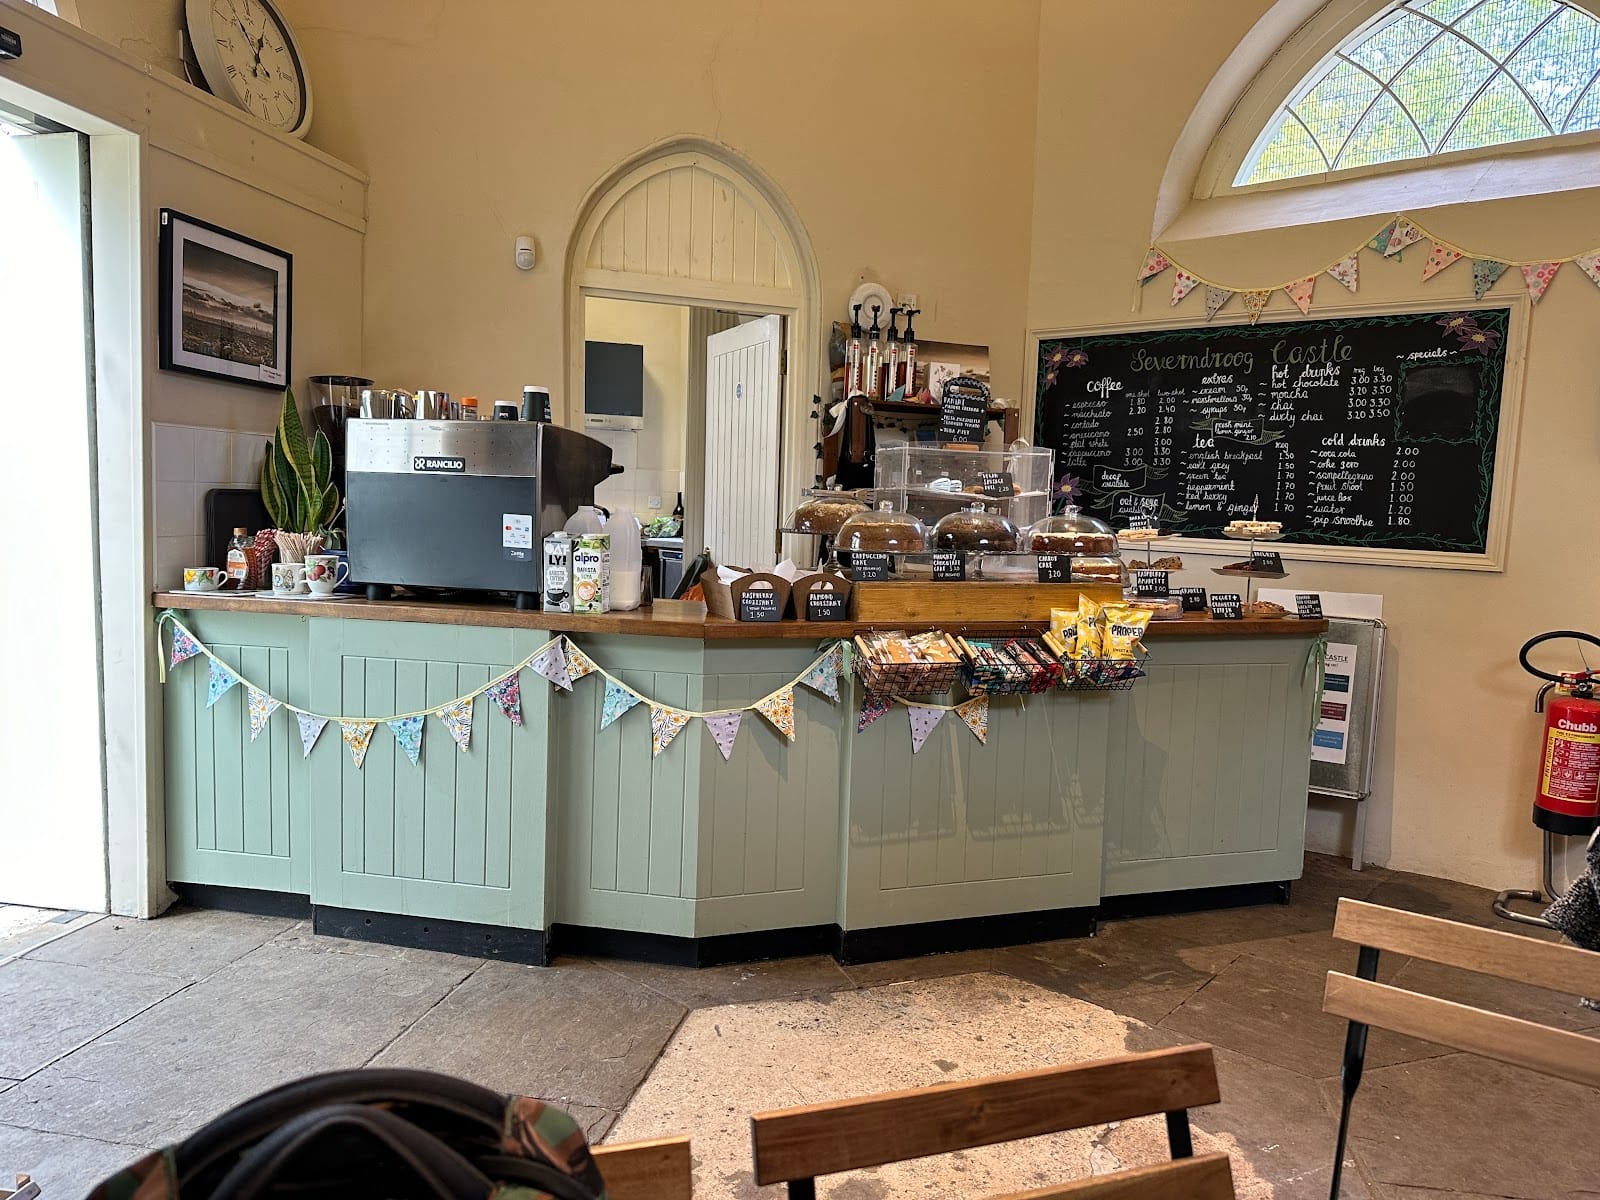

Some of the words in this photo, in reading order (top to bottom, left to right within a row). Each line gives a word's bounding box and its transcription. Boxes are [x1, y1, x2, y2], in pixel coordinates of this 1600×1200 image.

[1130, 347, 1254, 373] Severndroog
[1270, 335, 1353, 364] Castle
[1406, 347, 1447, 361] specials
[1272, 364, 1290, 380] hot
[1300, 362, 1341, 378] drinks
[1086, 377, 1125, 398] coffee
[1272, 378, 1287, 389] hot
[1292, 376, 1339, 388] chocolate
[1351, 376, 1370, 385] 3.00
[1373, 375, 1393, 383] 3.30
[1198, 386, 1226, 394] cream
[1348, 387, 1367, 396] 3.20
[1371, 385, 1392, 395] 3.50
[1071, 400, 1108, 409] espresso
[1270, 399, 1294, 410] chai
[1348, 398, 1367, 408] 3.00
[1369, 398, 1391, 407] 3.30
[1071, 409, 1112, 418] macchiato
[1200, 406, 1228, 419] syrups
[1269, 410, 1295, 428] dirty
[1300, 410, 1324, 421] chai
[1347, 411, 1366, 420] 3.20
[1368, 409, 1390, 418] 3.50
[1070, 419, 1100, 429] cortado
[1069, 430, 1111, 440] americano
[1192, 433, 1215, 448] tea
[1322, 433, 1345, 446] cold
[1348, 433, 1386, 447] drinks
[1069, 439, 1085, 449] flat
[1088, 438, 1110, 447] white
[1068, 450, 1112, 459] cappuccino
[1188, 450, 1220, 463] english
[1224, 450, 1263, 465] breakfast
[1318, 450, 1336, 458] coca
[1337, 448, 1357, 458] cola
[1396, 446, 1420, 456] 2.00
[426, 460, 463, 469] RANCILIO
[1067, 457, 1087, 466] latte
[1187, 461, 1206, 470] earl
[1209, 463, 1230, 473] grey
[1317, 458, 1336, 468] coke
[1340, 461, 1359, 470] zero
[1393, 460, 1416, 468] 2.00
[1186, 474, 1209, 483] green
[1213, 472, 1227, 480] tea
[1316, 470, 1374, 484] sanpellegrino
[1391, 471, 1415, 480] 2.00
[1186, 480, 1235, 494] peppermint
[1316, 482, 1337, 493] fruit
[1341, 480, 1364, 491] shoot
[1390, 482, 1414, 492] 1.50
[1186, 492, 1200, 500] red
[1203, 492, 1227, 505] berry
[1314, 494, 1337, 504] juice
[1337, 492, 1352, 502] box
[1390, 493, 1414, 503] 1.00
[1185, 500, 1212, 511] lemon
[1216, 502, 1222, 511] &
[1274, 502, 1294, 512] 1.70
[1313, 503, 1346, 514] water
[1388, 504, 1412, 515] 1.20
[1312, 515, 1329, 527] pip
[1332, 514, 1374, 527] smoothie
[1388, 516, 1410, 526] 1.80
[549, 554, 567, 566] LY!
[574, 552, 599, 564] alpro
[851, 552, 887, 560] CAPPUCCINO
[1111, 624, 1144, 638] PROPER
[1558, 719, 1597, 733] Chubb
